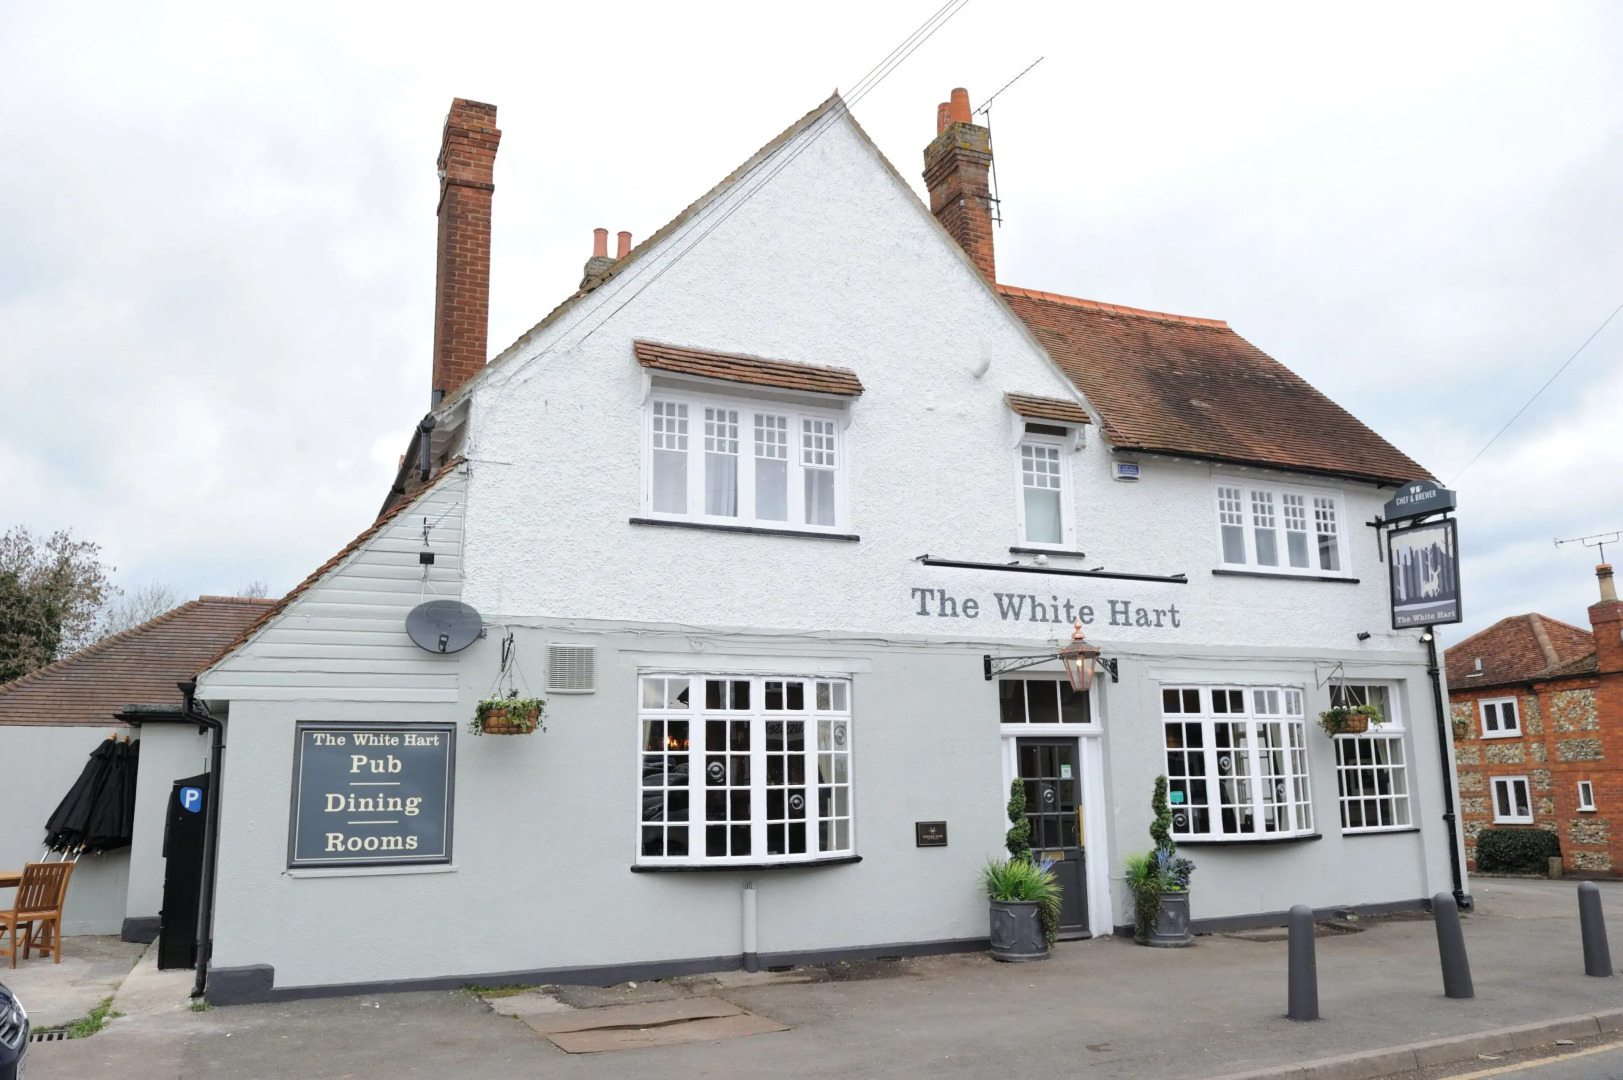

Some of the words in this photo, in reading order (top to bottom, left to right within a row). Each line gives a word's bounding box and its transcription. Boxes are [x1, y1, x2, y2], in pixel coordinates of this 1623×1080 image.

[1396, 495, 1409, 506] CHEF
[1410, 494, 1415, 503] &
[1415, 489, 1437, 502] BREWER
[911, 587, 980, 619] The
[993, 592, 1095, 625] White
[1107, 599, 1181, 628] Hart
[1396, 616, 1411, 624] The
[1412, 613, 1435, 622] White
[1437, 610, 1456, 619] Hart
[313, 733, 346, 746] The
[353, 733, 400, 746] White
[403, 734, 440, 746] Hart
[350, 754, 402, 774] Pub
[185, 789, 199, 808] P
[324, 792, 422, 816] Dining
[324, 832, 418, 852] Rooms
